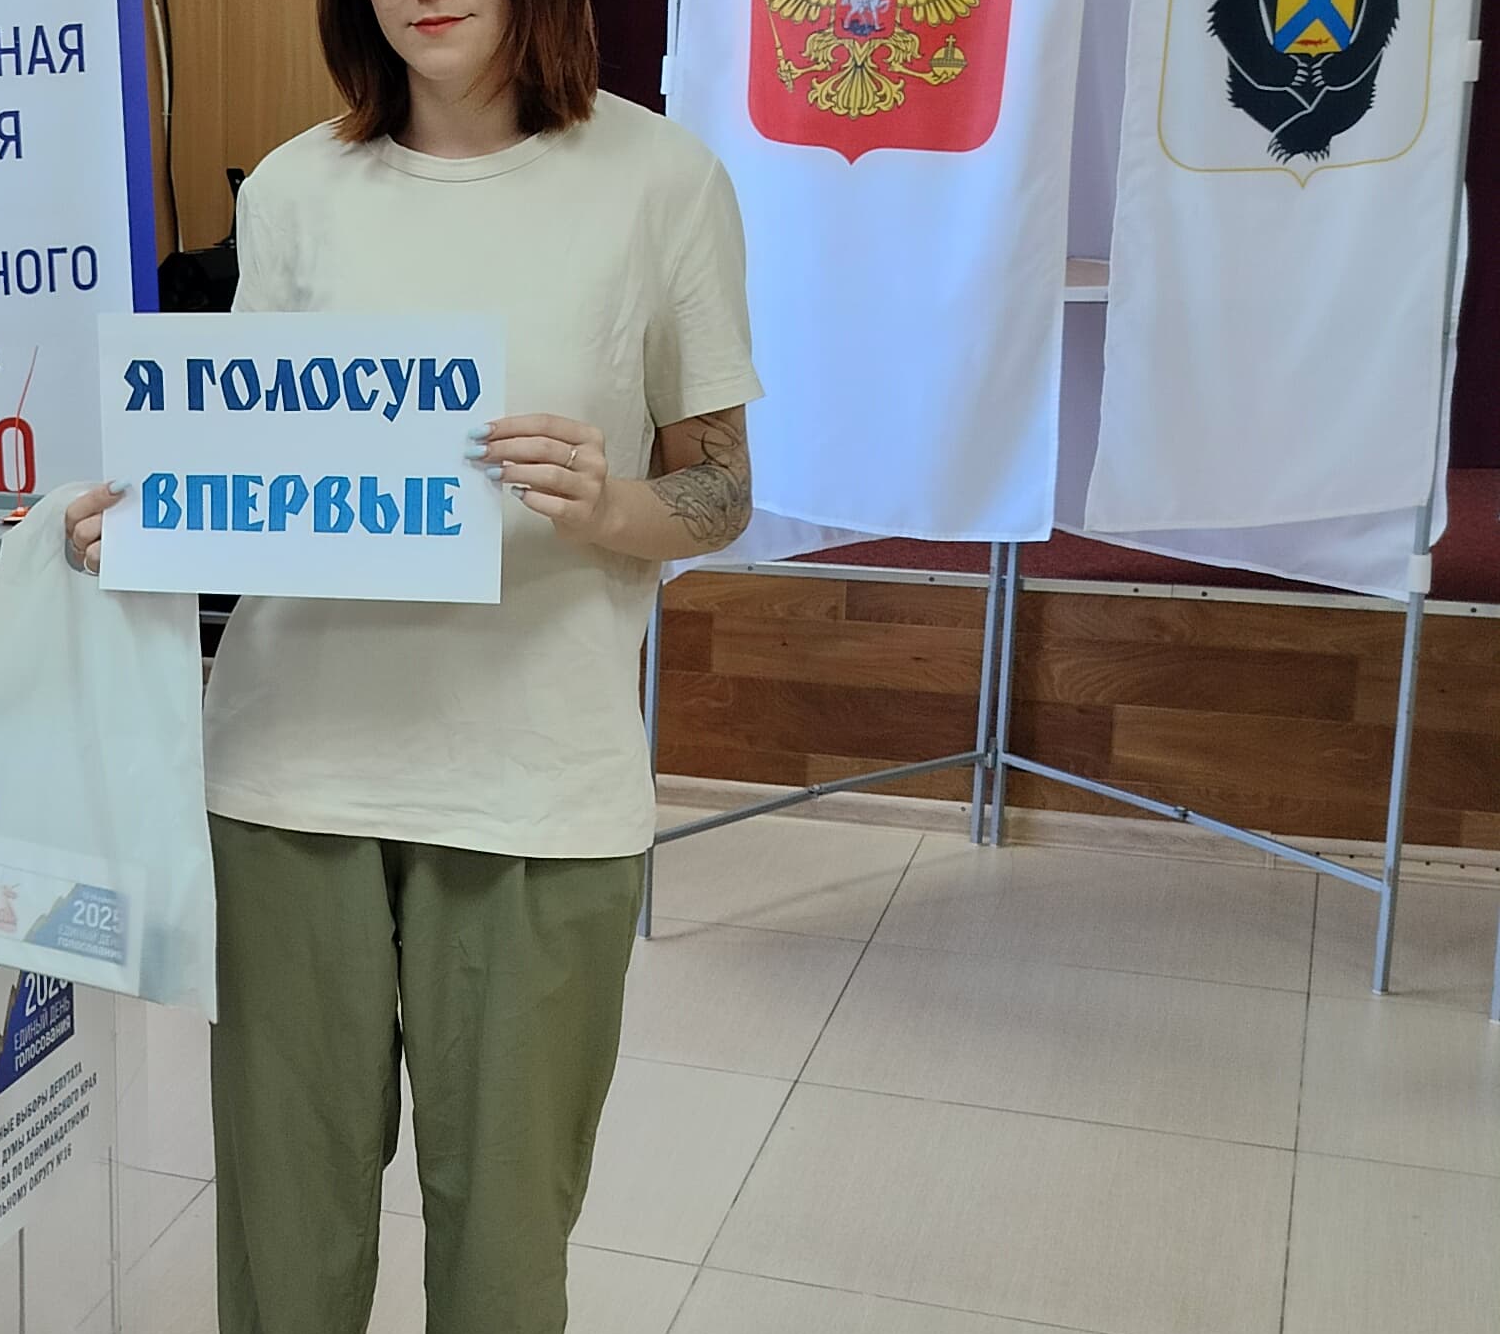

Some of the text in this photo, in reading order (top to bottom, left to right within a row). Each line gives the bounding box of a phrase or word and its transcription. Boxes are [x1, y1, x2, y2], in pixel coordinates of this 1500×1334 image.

[123, 357, 481, 422] Я ГОЛОСУЮ
[141, 472, 462, 536] ВПЕРВЫЕ
[14, 995, 71, 1051] ЕДИНЫЙ ДЕНЬ
[25, 972, 69, 1017] 202
[14, 1015, 71, 1072] голосования
[1, 1133, 25, 1169] ДУМЫ
[26, 1087, 79, 1145] ХАБАРОВСКОГО
[80, 1071, 98, 1103] КРАЯ
[15, 1088, 49, 1130] ВЫБОРЫ
[49, 1061, 82, 1101] ДЕПУТАТА
[12, 1162, 23, 1183] ПО
[23, 1101, 91, 1172] ОДНОМАНДАТНОМУ
[28, 1160, 56, 1193] ОКРУГУ
